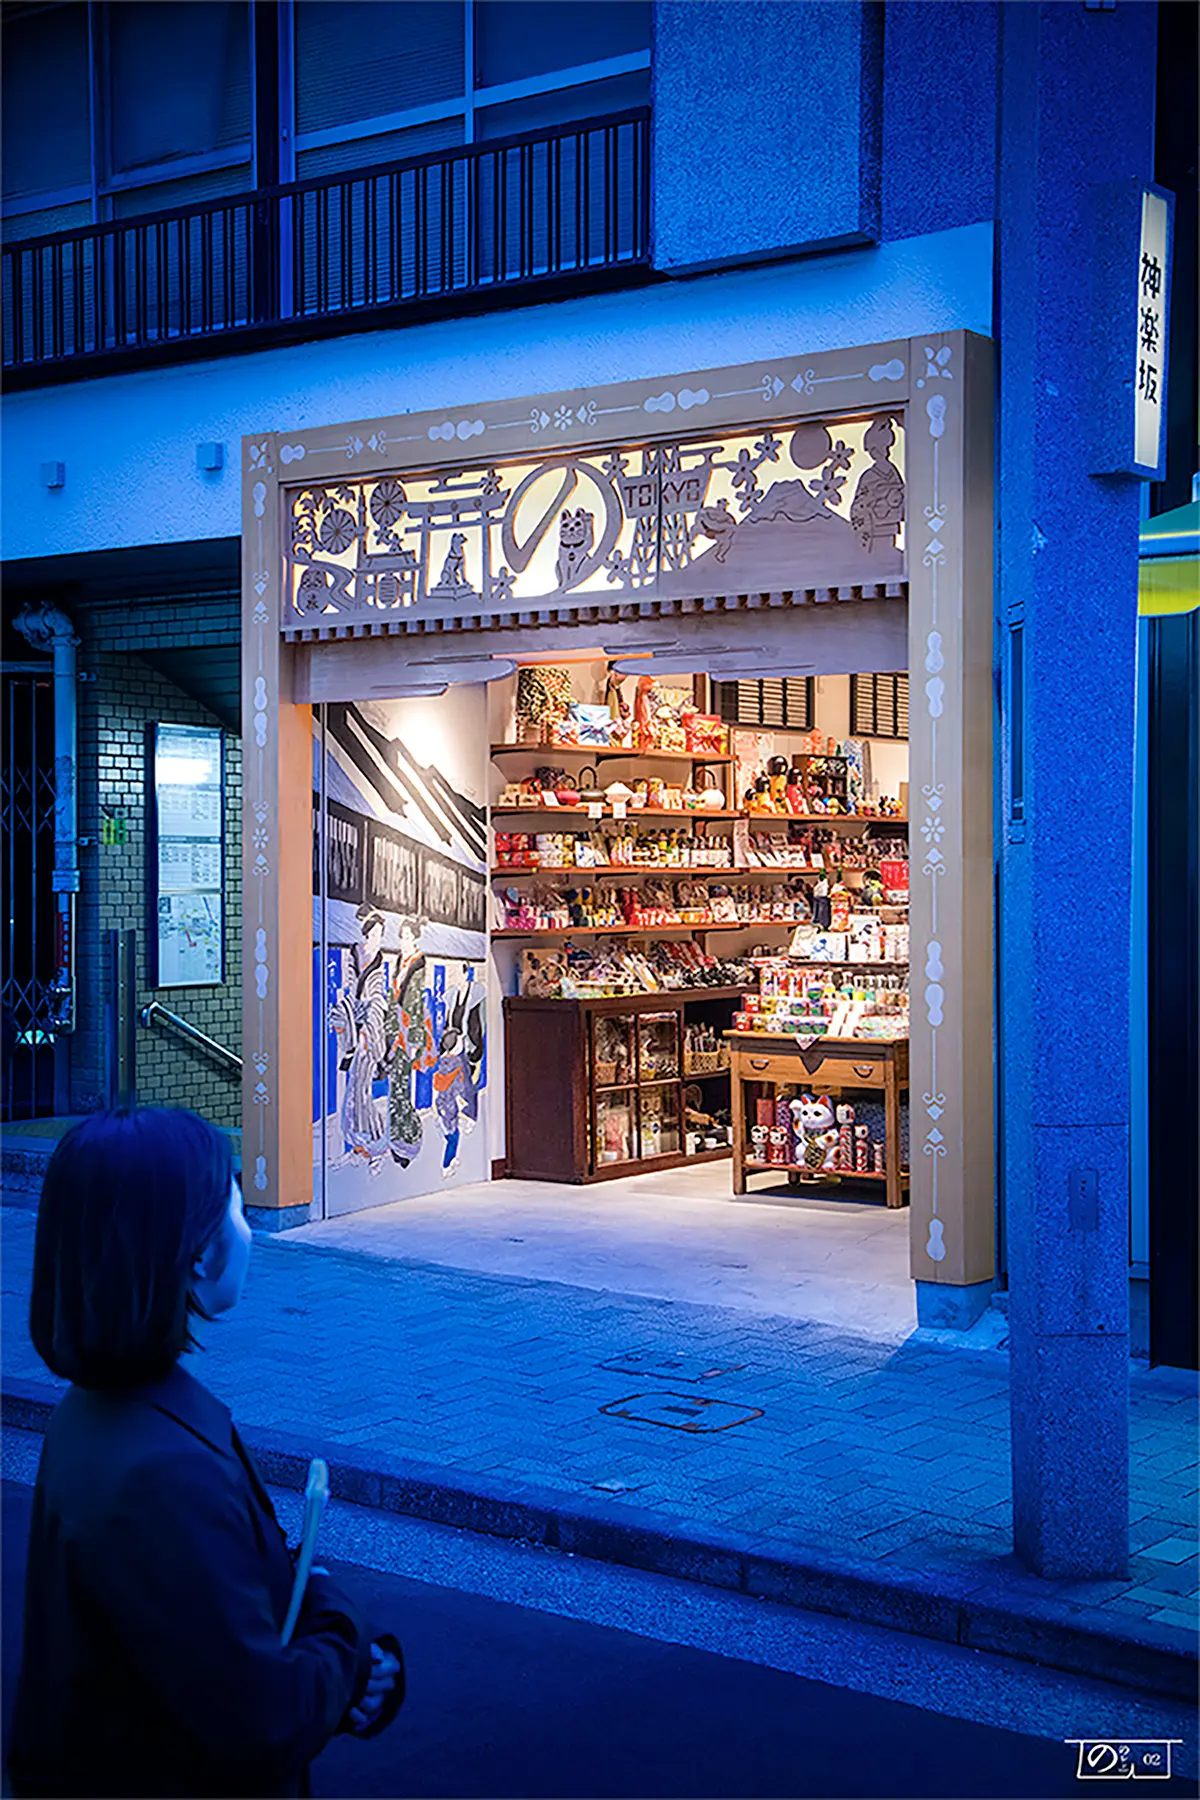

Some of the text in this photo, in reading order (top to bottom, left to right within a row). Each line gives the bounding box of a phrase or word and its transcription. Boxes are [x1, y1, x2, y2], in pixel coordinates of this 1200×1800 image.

[1139, 252, 1162, 405] 神楽坂
[624, 478, 700, 509] TOKYO
